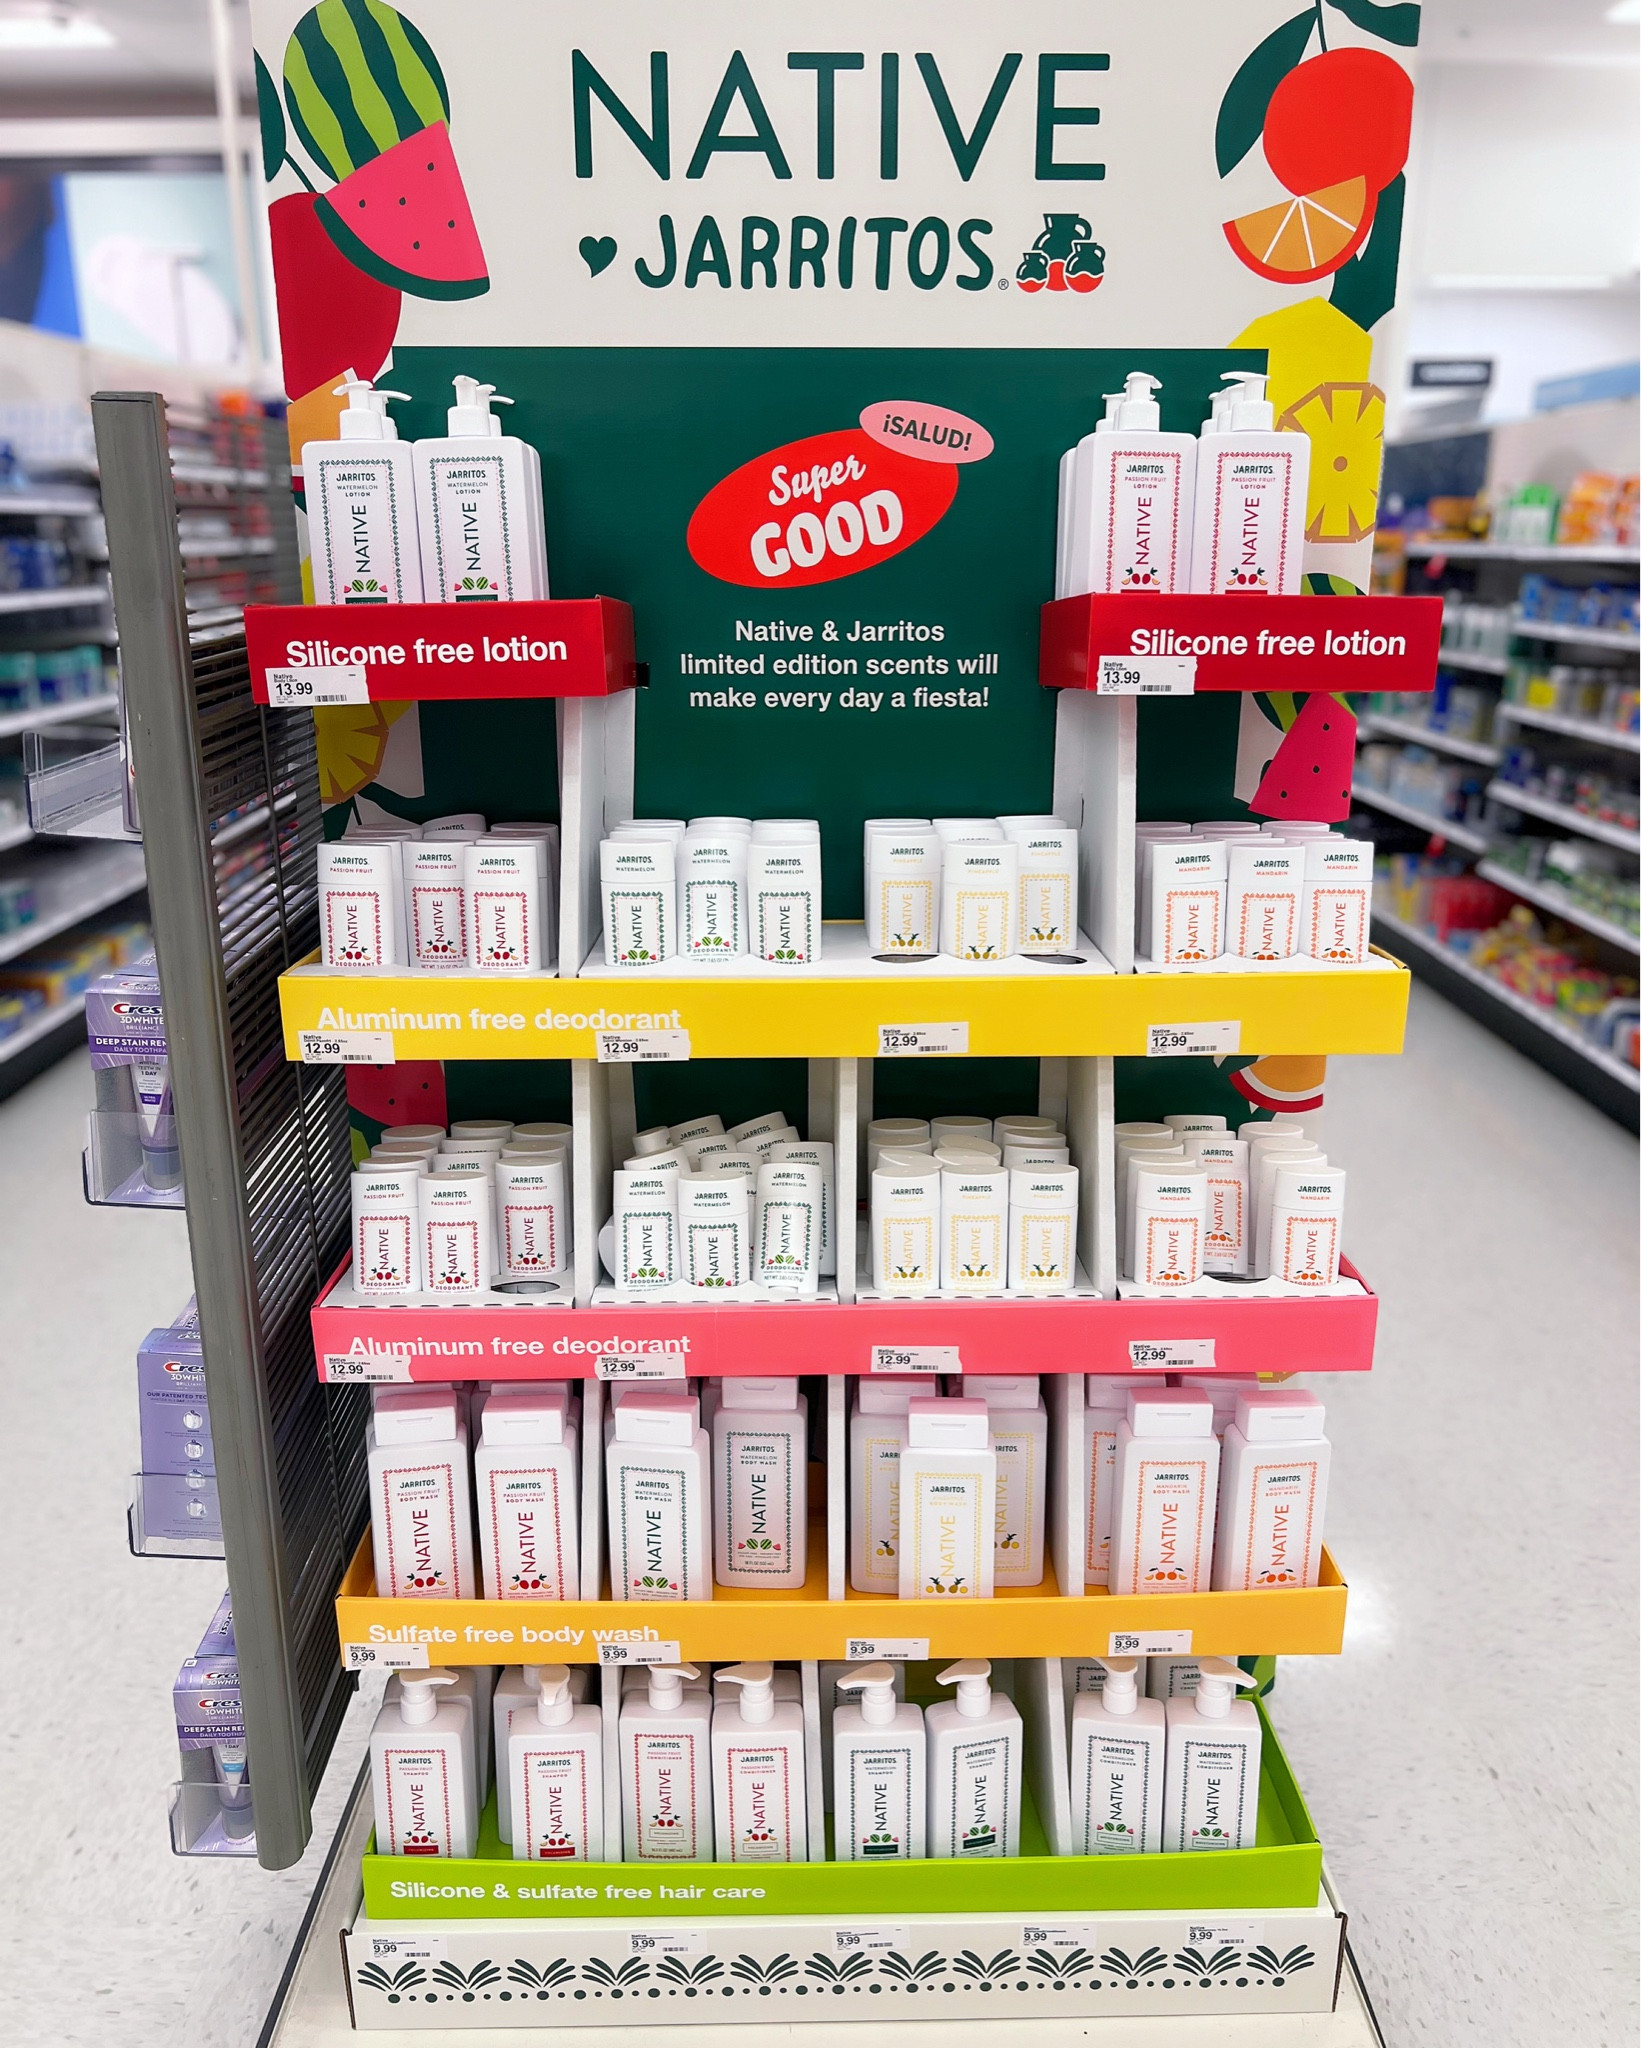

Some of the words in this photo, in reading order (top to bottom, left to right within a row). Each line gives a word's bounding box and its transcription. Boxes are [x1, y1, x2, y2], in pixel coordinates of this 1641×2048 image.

[571, 48, 1110, 182] NATIVE
[634, 214, 994, 292] JARRITOS
[883, 414, 972, 451] ¡SALUD!
[336, 473, 376, 481] JARRITOS
[446, 470, 486, 479] JARRITOS
[1126, 464, 1165, 474] JARRITOS
[1233, 465, 1273, 474] JARRITOS
[768, 454, 866, 506] Super
[352, 505, 371, 572] NATIVE
[462, 502, 481, 570] NATIVE
[750, 489, 903, 577] GOOD
[1135, 497, 1152, 565] NATIVE
[1241, 497, 1259, 565] NATIVE
[735, 621, 814, 641] Native
[822, 621, 839, 641] &
[847, 621, 945, 641] Jarritos
[286, 641, 406, 667] Silicone
[412, 638, 475, 664] free
[483, 635, 568, 662] lotion
[1129, 628, 1248, 656] Silicone
[1256, 629, 1315, 655] free
[1324, 629, 1406, 656] lotion
[681, 654, 764, 675] limited
[773, 654, 858, 675] edition
[866, 657, 949, 675] scents
[957, 654, 998, 674] will
[1103, 671, 1140, 684] 13.99
[275, 682, 313, 696] 13.99
[689, 688, 756, 708] make
[764, 692, 831, 712] every
[839, 688, 883, 712] day
[891, 692, 906, 708] a
[913, 687, 989, 708] fiesta!
[1028, 841, 1062, 849] JARRITOS
[332, 857, 369, 865] JARRITOS
[417, 854, 453, 862] JARRITOS
[479, 858, 516, 866] JARRITOS
[616, 856, 653, 864] JARRITOS
[964, 858, 1000, 866] JARRITOS
[1175, 855, 1211, 864] JARRITOS
[432, 900, 445, 942] NATIVE
[707, 893, 717, 935] NATIVE
[347, 905, 358, 948] NATIVE
[494, 905, 506, 949] NATIVE
[631, 905, 642, 948] NATIVE
[780, 905, 791, 948] NATIVE
[978, 905, 989, 947] NATIVE
[1188, 904, 1199, 948] NATIVE
[1262, 907, 1275, 950] NATIVE
[1334, 903, 1346, 946] NATIVE
[317, 1007, 461, 1031] Aluminum
[469, 1008, 526, 1029] free
[535, 1008, 682, 1030] deodorant
[122, 1038, 150, 1046] STAIN
[305, 1042, 340, 1055] 12.99
[603, 1042, 639, 1054] 12.99
[884, 1036, 918, 1047] 12.99
[1152, 1036, 1187, 1048] 12.99
[630, 1180, 664, 1188] JARRITOS
[773, 1172, 805, 1180] JARRITOS
[694, 1192, 728, 1200] JARRITOS
[1157, 1186, 1192, 1194] JARRITOS
[1213, 1191, 1224, 1230] NATIVE
[780, 1214, 792, 1254] NATIVE
[379, 1229, 389, 1270] NATIVE
[447, 1234, 458, 1274] NATIVE
[642, 1225, 653, 1267] NATIVE
[1168, 1230, 1179, 1270] NATIVE
[1306, 1230, 1318, 1270] NATIVE
[708, 1237, 718, 1276] NATIVE
[349, 1336, 483, 1356] Aluminum
[491, 1337, 544, 1355] free
[552, 1336, 691, 1354] deodorant
[1133, 1351, 1166, 1361] 12.99
[330, 1364, 364, 1375] 12.99
[602, 1362, 636, 1373] 12.99
[878, 1355, 911, 1365] 12.99
[400, 1479, 436, 1489] JARRITOS
[636, 1481, 670, 1489] JARRITOS
[1154, 1473, 1190, 1481] JARRITOS
[1267, 1475, 1301, 1483] JARRITOS
[752, 1474, 766, 1533] NATIVE
[412, 1509, 432, 1571] NATIVE
[518, 1512, 536, 1573] NATIVE
[646, 1510, 662, 1572] NATIVE
[1160, 1503, 1178, 1563] NATIVE
[1271, 1505, 1289, 1566] NATIVE
[940, 1515, 955, 1577] NATIVE
[369, 1625, 457, 1642] Sulfate
[464, 1626, 514, 1642] free
[522, 1626, 584, 1645] body
[591, 1626, 659, 1641] wash
[1115, 1641, 1139, 1649] 9.99
[350, 1651, 376, 1662] 9.99
[602, 1649, 628, 1659] 9.99
[850, 1646, 875, 1654] 9.99
[965, 1748, 996, 1759] JARRITOS
[1101, 1746, 1135, 1755] JARRITOS
[752, 1783, 766, 1829] NATIVE
[875, 1783, 887, 1830] NATIVE
[975, 1775, 987, 1823] NATIVE
[1110, 1773, 1124, 1820] NATIVE
[411, 1784, 425, 1831] NATIVE
[390, 1881, 488, 1900] Silicone
[492, 1884, 510, 1899] &
[517, 1884, 598, 1900] sulfate
[604, 1884, 652, 1900] free
[659, 1885, 705, 1899] hair
[713, 1887, 766, 1899] care
[631, 1939, 655, 1949] 9.99
[836, 1936, 861, 1946] 9.99
[1023, 1932, 1048, 1942] 9.99
[1188, 1931, 1214, 1941] 9.99
[373, 1945, 397, 1955] 9.99
